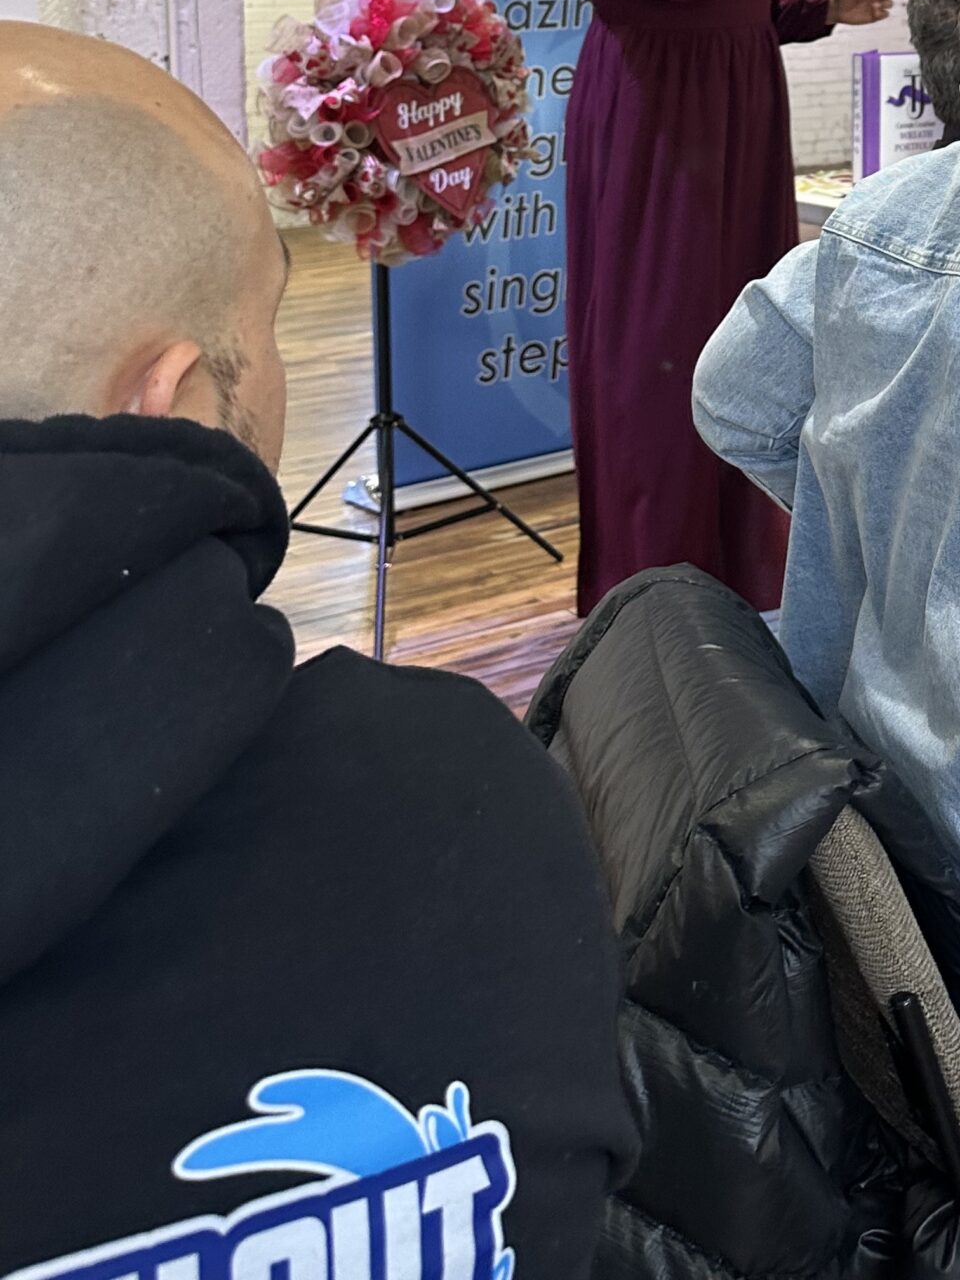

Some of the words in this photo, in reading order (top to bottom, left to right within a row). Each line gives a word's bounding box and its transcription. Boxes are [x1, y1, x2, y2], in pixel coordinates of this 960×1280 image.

[397, 92, 464, 129] Happy
[429, 166, 473, 194] Day
[465, 194, 555, 242] with
[479, 337, 568, 382] step
